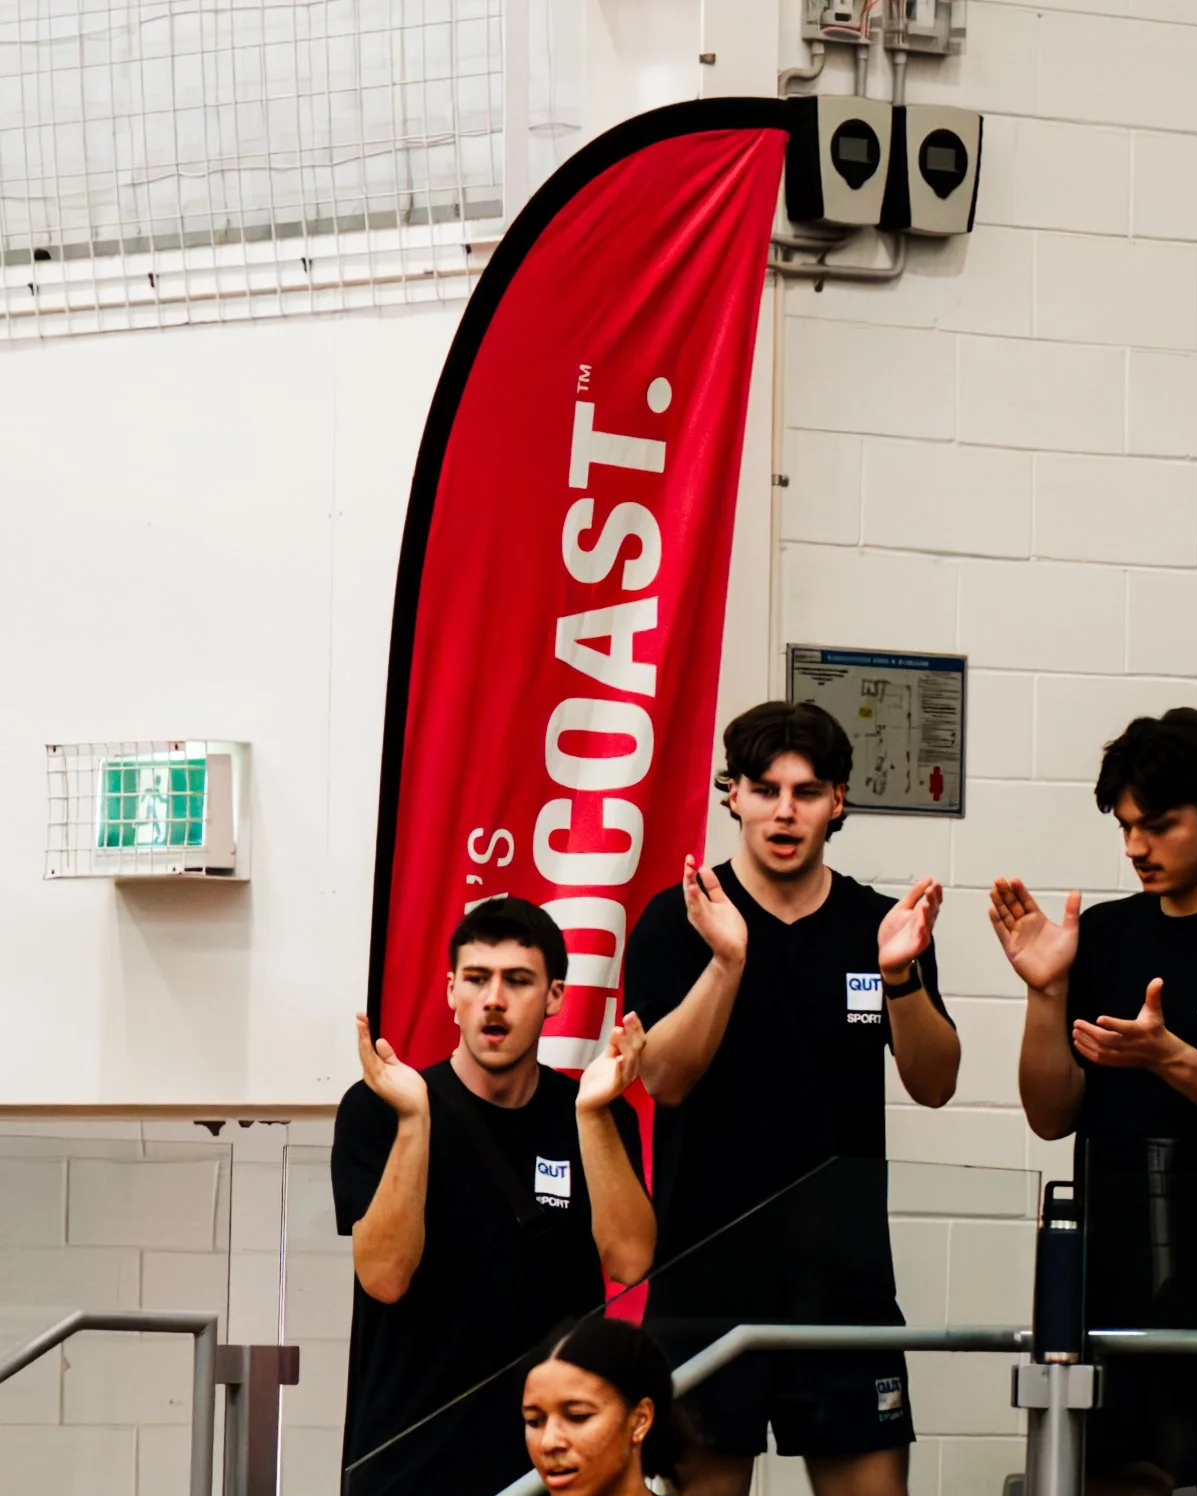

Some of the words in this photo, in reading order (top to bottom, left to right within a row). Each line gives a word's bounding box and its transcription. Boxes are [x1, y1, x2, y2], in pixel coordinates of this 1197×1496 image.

[848, 978, 882, 991] QUT
[846, 1013, 881, 1024] SPORT
[537, 1162, 568, 1178] QUT
